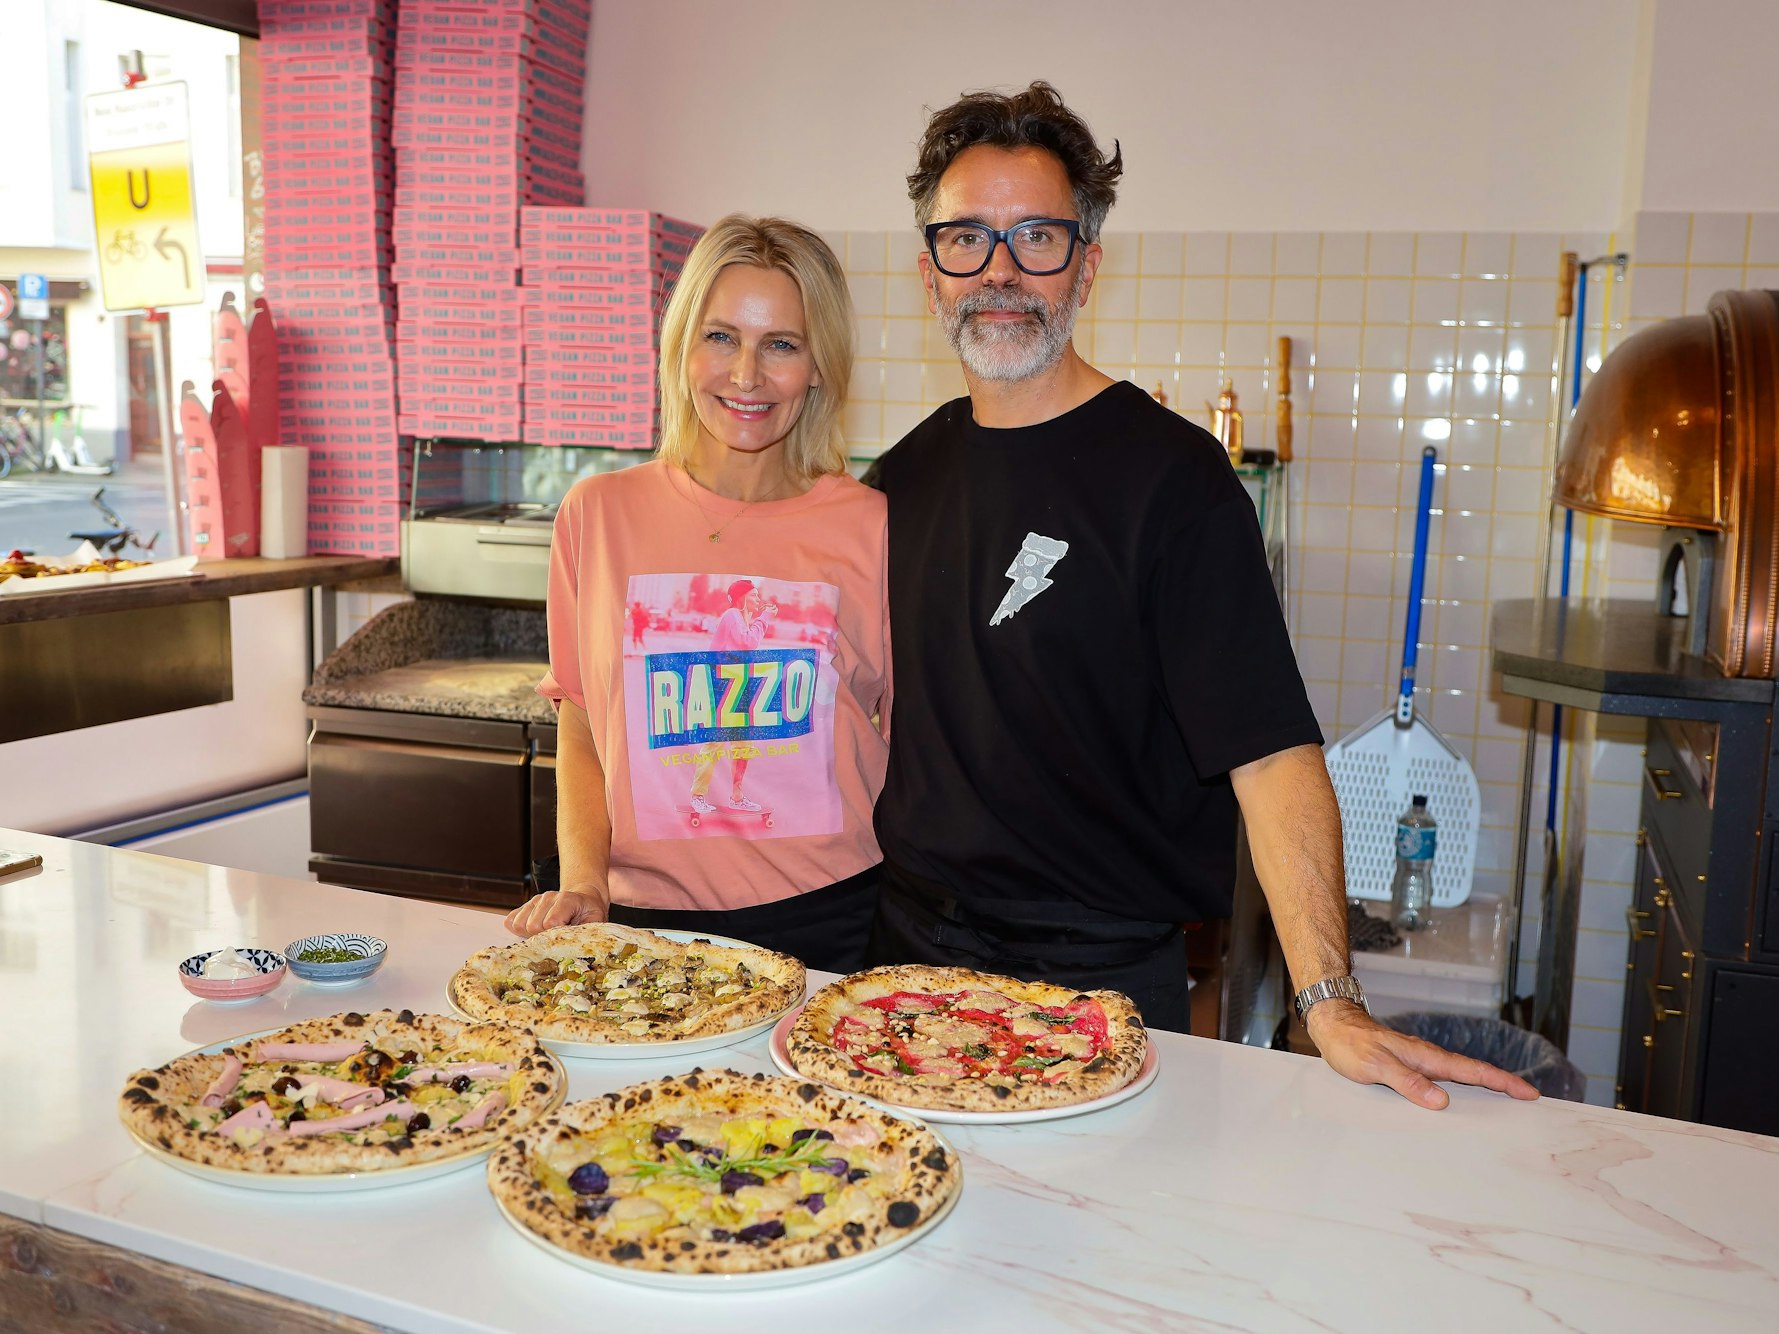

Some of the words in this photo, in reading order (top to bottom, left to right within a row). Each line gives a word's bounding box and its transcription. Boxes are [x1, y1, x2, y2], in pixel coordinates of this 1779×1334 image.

[127, 168, 150, 210] U
[650, 659, 816, 736] RAZZO
[660, 751, 716, 768] VEGAN
[716, 748, 762, 762] PIZZA
[766, 742, 800, 757] BAR
